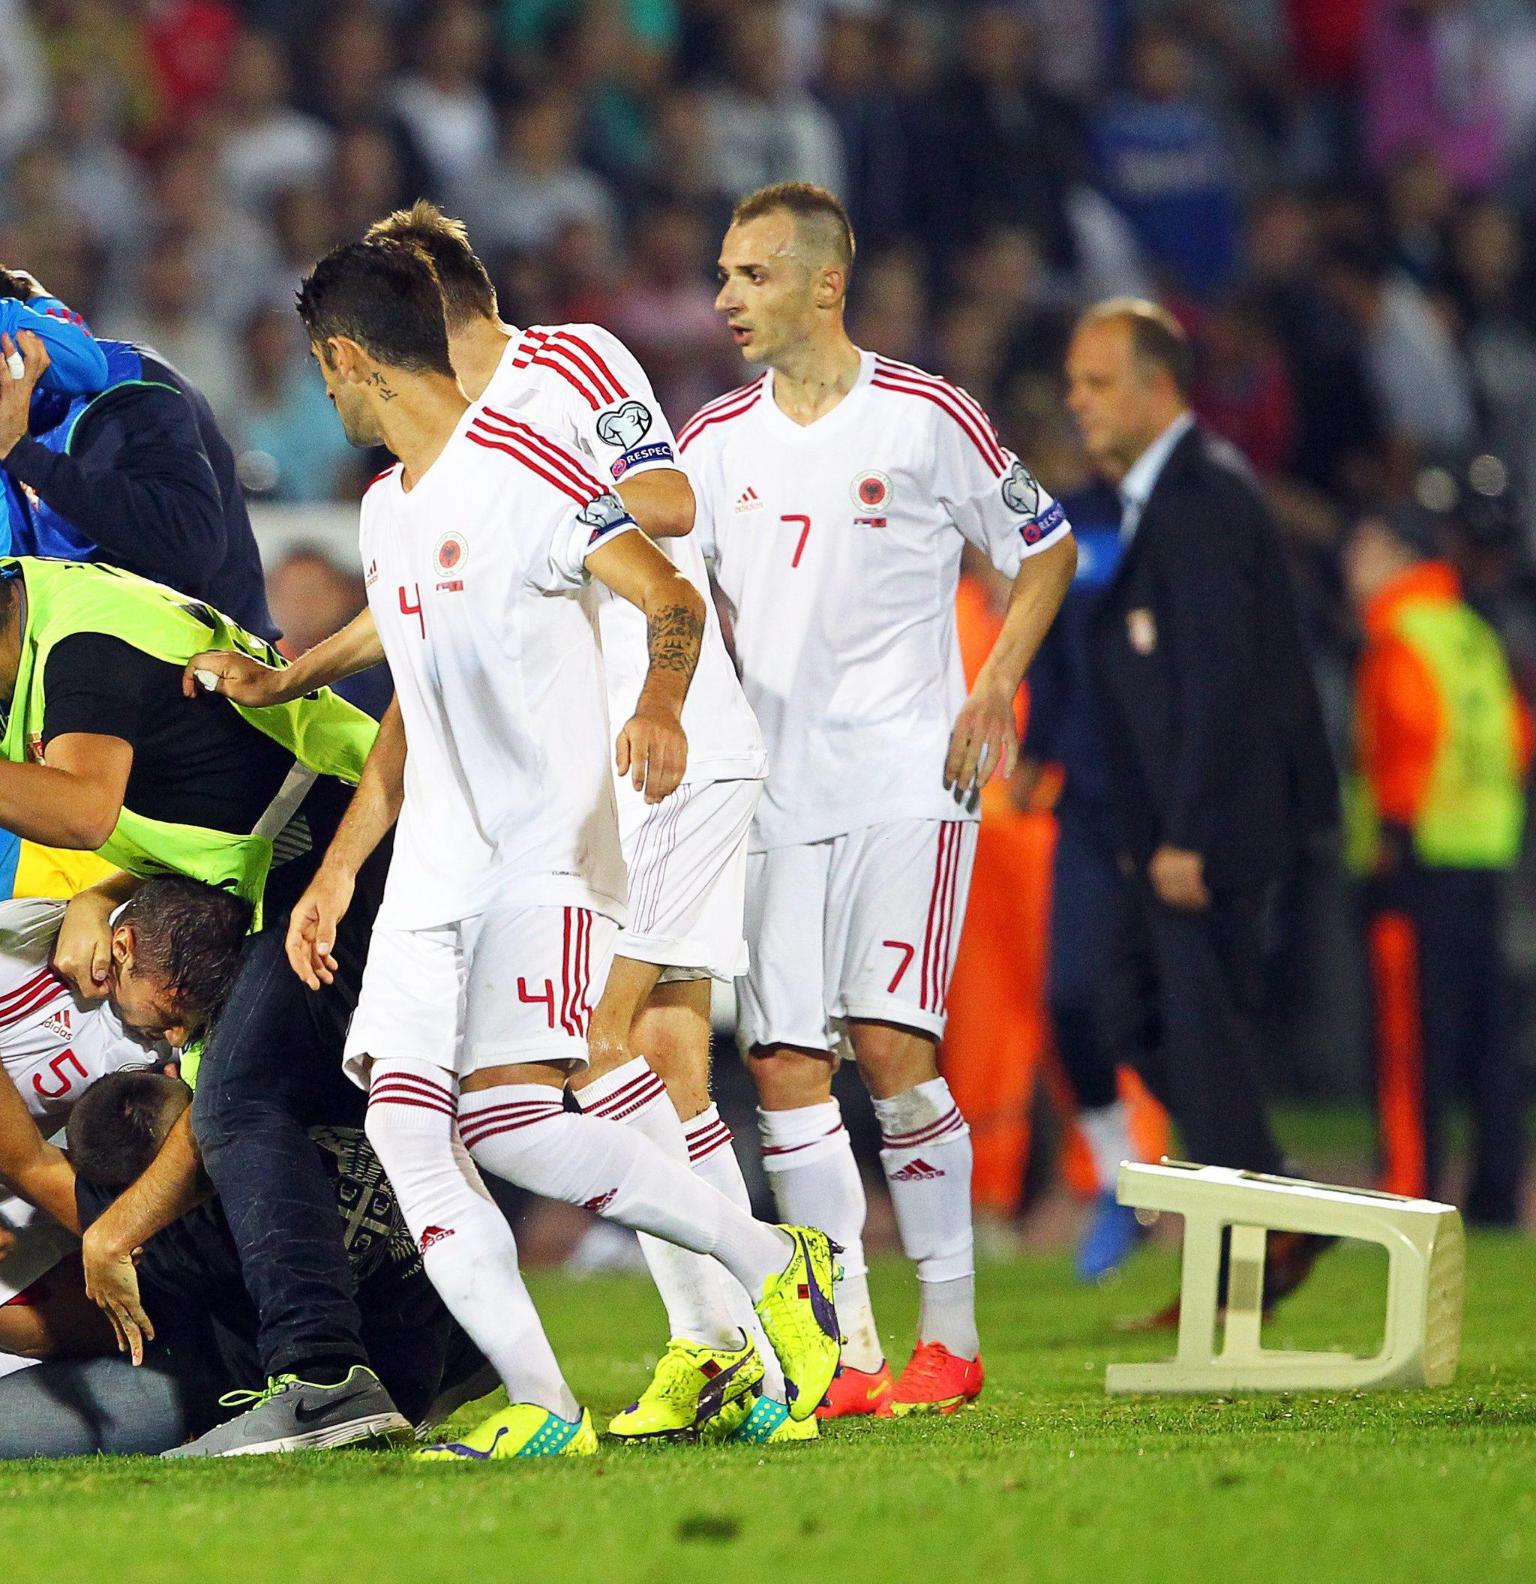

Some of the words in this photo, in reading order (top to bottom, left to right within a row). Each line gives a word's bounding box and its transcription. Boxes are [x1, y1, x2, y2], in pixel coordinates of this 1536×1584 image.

[625, 445, 674, 464] RESPEC
[780, 514, 811, 569] 7
[398, 582, 426, 640] 4
[883, 940, 915, 993] 7
[516, 975, 555, 1029] 4
[42, 1017, 73, 1041] didas
[32, 1048, 89, 1098] 5
